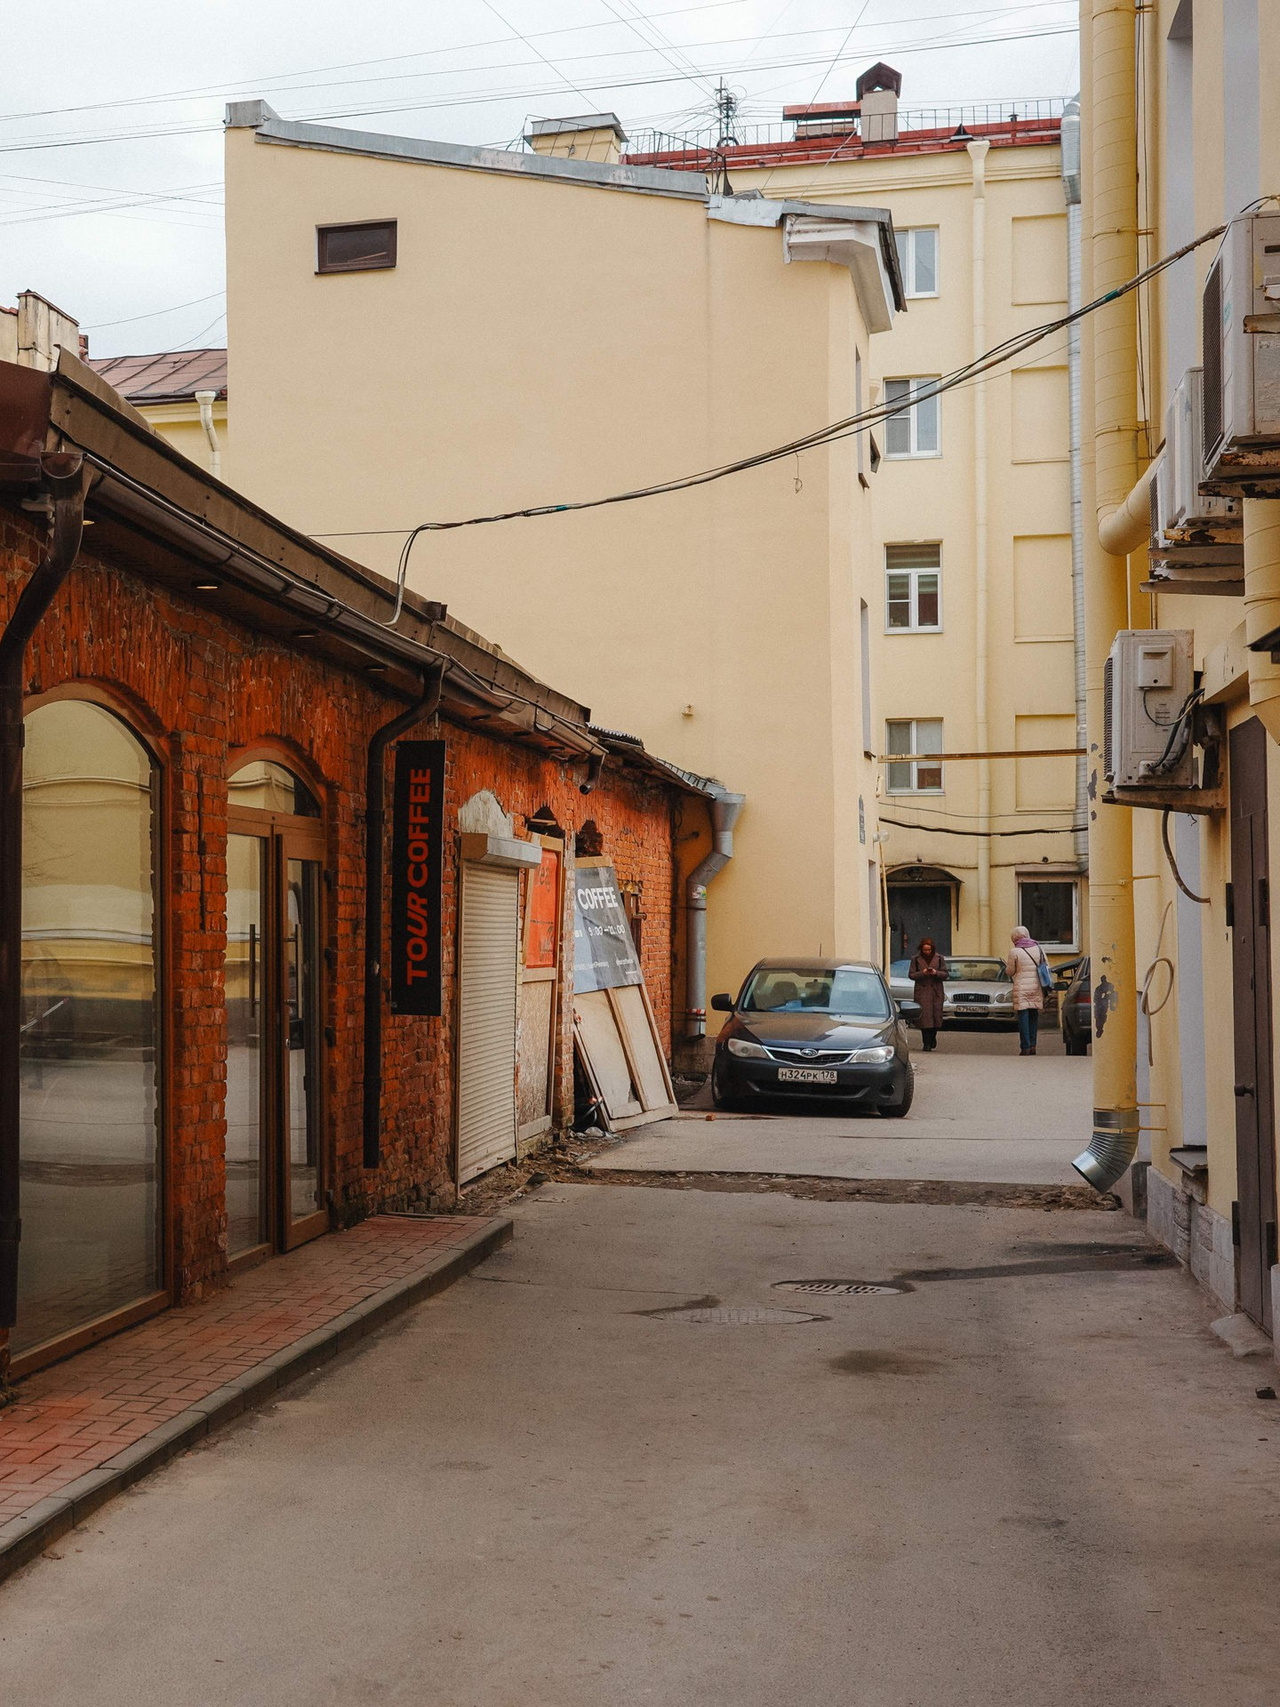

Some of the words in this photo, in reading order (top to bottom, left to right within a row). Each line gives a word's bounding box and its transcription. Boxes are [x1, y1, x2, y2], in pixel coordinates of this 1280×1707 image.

[407, 768, 431, 889] COFFEE
[577, 886, 619, 910] COFFEE
[406, 891, 429, 986] TOUR
[820, 1070, 835, 1080] 178
